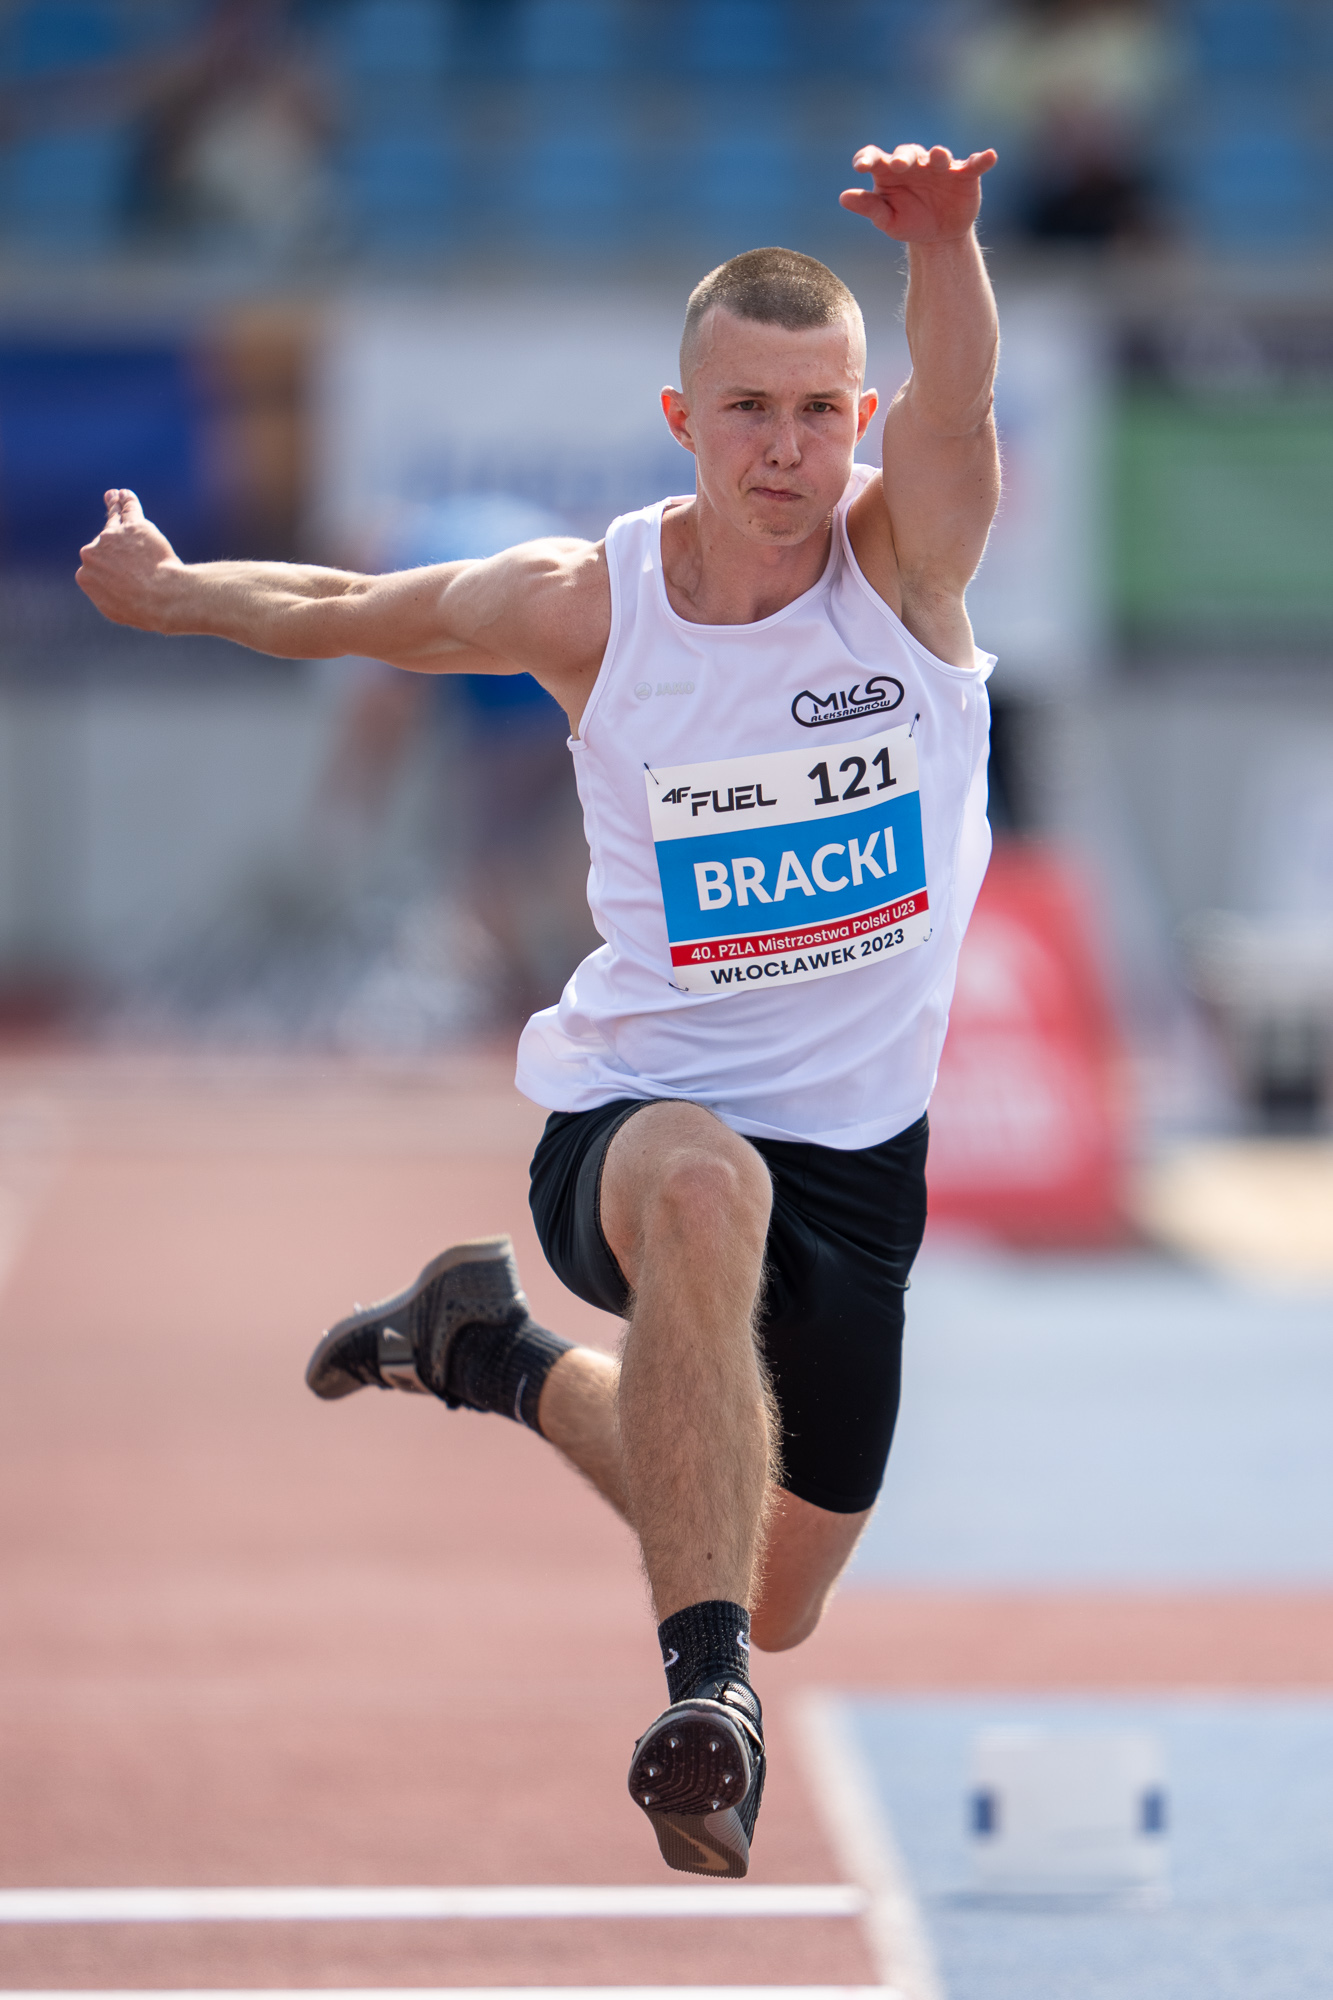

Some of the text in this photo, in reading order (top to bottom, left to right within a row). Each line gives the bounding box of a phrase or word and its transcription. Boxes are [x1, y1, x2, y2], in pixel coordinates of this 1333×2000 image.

[655, 682, 695, 696] JAKO
[811, 700, 890, 723] ALEKSANDRÓW
[662, 784, 777, 816] 4F FUEL
[808, 747, 897, 805] 121
[694, 826, 897, 911] BRACKI
[691, 900, 916, 961] 40. PZLA Mistrzostwa Polski U23
[711, 928, 905, 985] WŁOCŁAWEK 2023
